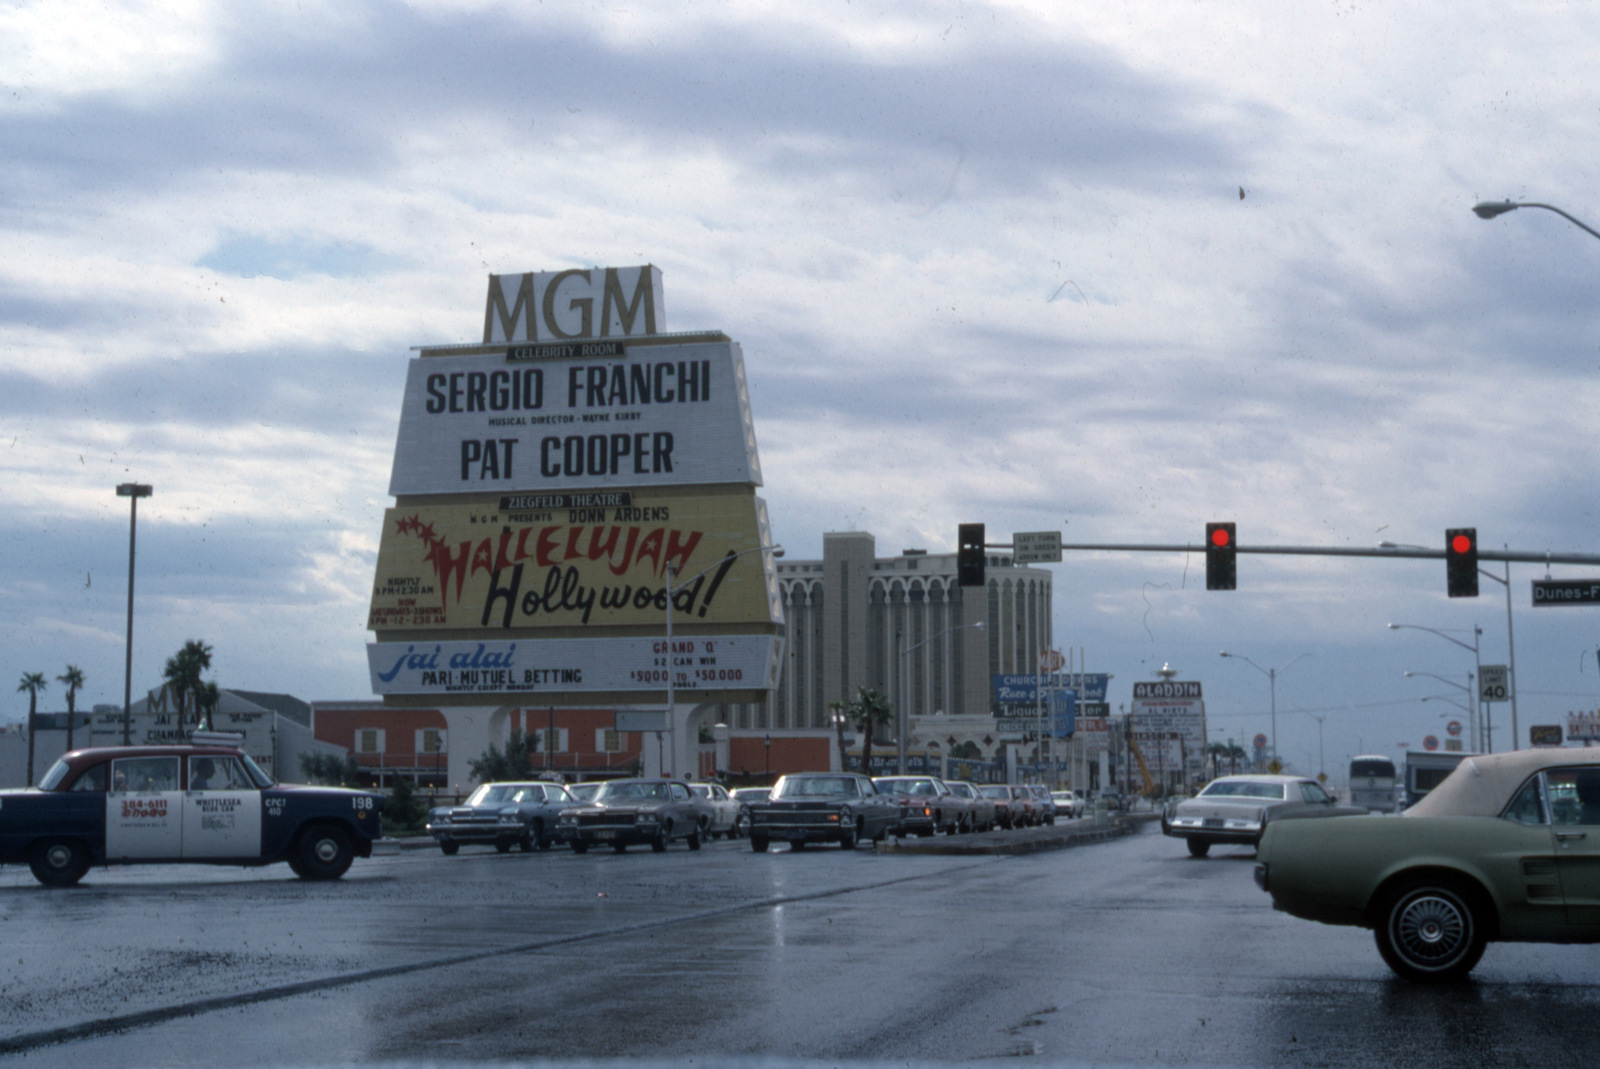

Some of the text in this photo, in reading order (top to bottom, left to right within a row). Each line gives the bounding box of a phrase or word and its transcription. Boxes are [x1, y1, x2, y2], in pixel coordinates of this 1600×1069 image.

[483, 265, 657, 343] MGM
[514, 343, 617, 359] CELEBRITY ROOM
[426, 360, 711, 414] SERGIO FRANCHI
[488, 417, 527, 427] MUSICAL
[615, 411, 642, 421] KIRBY
[461, 432, 675, 481] PAT COOPER
[508, 493, 623, 509] ZIEGFELD THEATRE
[508, 513, 552, 523] PRESENTS
[569, 508, 606, 524] DONN
[436, 525, 703, 614] HALLELUJAH
[481, 527, 738, 628] Hollywood!
[653, 641, 694, 653] GRAND
[378, 643, 517, 682] jai alai
[674, 657, 693, 666] CAN
[699, 657, 716, 665] WIN
[525, 669, 582, 684] BETTING
[676, 672, 687, 681] TO
[1482, 668, 1504, 676] SPEED
[998, 687, 1027, 699] Race
[1136, 683, 1199, 697] ALADDIN
[1483, 685, 1505, 698] 40
[154, 714, 171, 725] JAI
[195, 798, 242, 807] WHITTLESEA
[352, 796, 373, 809] 198
[268, 807, 281, 816] 410
